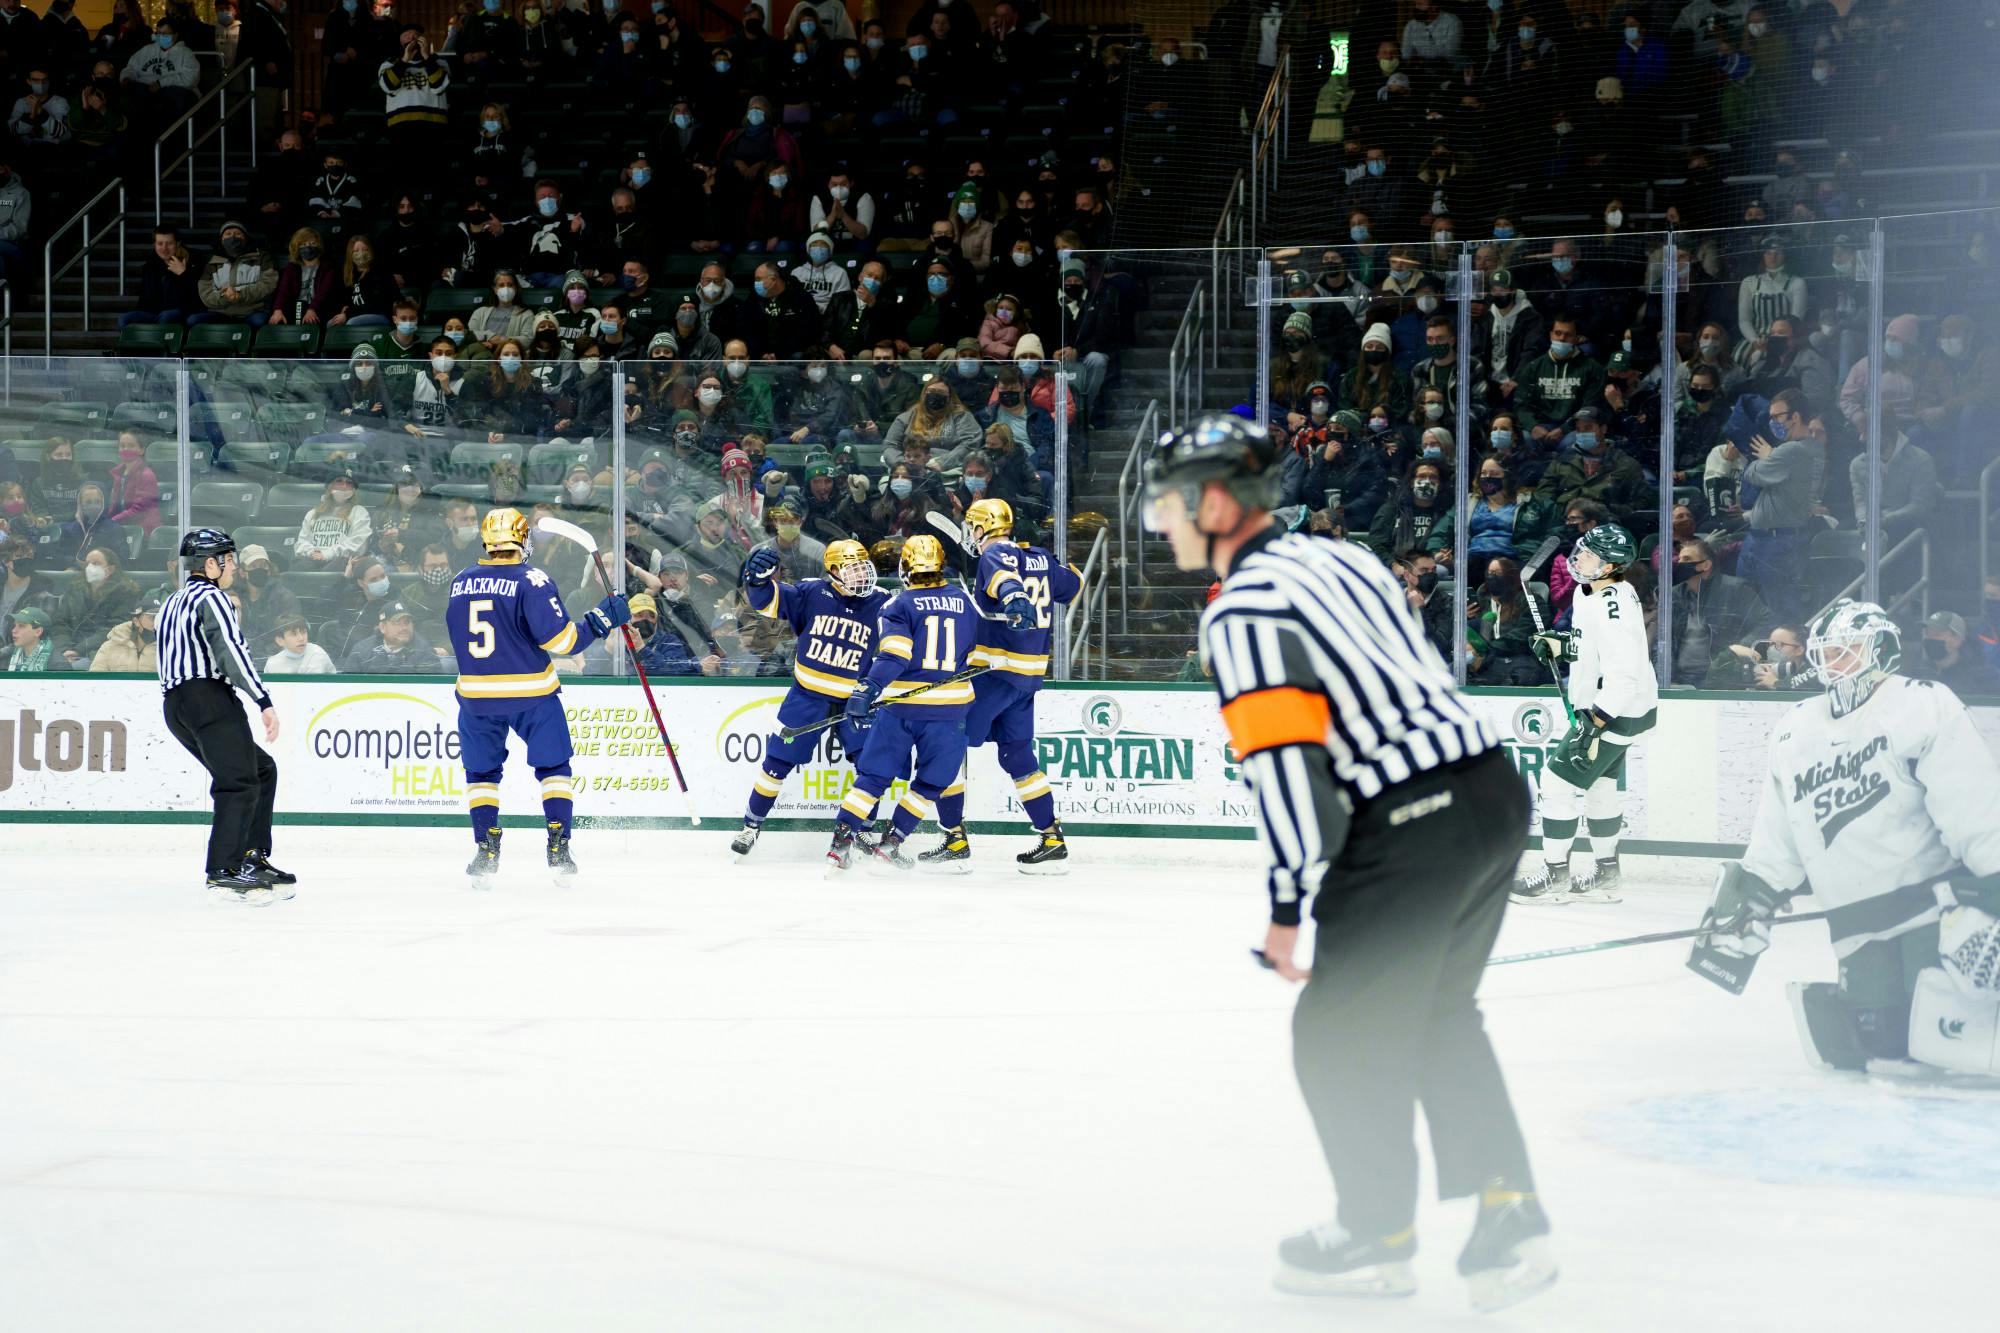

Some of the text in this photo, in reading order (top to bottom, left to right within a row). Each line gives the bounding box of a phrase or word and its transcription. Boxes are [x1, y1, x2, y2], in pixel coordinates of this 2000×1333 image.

[311, 520, 351, 536] MICHIGAN
[313, 534, 341, 547] STATE
[450, 578, 519, 598] BLACKMUN
[549, 597, 563, 618] 5
[914, 596, 964, 614] STRAND
[1607, 600, 1620, 620] 2
[468, 599, 496, 659] 5
[809, 615, 871, 650] NOTRE
[922, 615, 957, 672] 11
[805, 637, 862, 672] DAME
[566, 707, 638, 723] OCATED
[569, 725, 661, 739] ASTWOOD
[314, 720, 462, 769] complete
[1033, 737, 1193, 780] PARTAN
[1794, 735, 1888, 803] Michigan
[391, 763, 465, 796] HEAL
[593, 776, 669, 791] 574-5595
[1066, 782, 1136, 792] FUND
[385, 798, 397, 806] Feel
[417, 799, 440, 807] Perform
[810, 803, 828, 811] better.
[1094, 797, 1195, 816] CHAMPIONS
[1813, 771, 1882, 823] State
